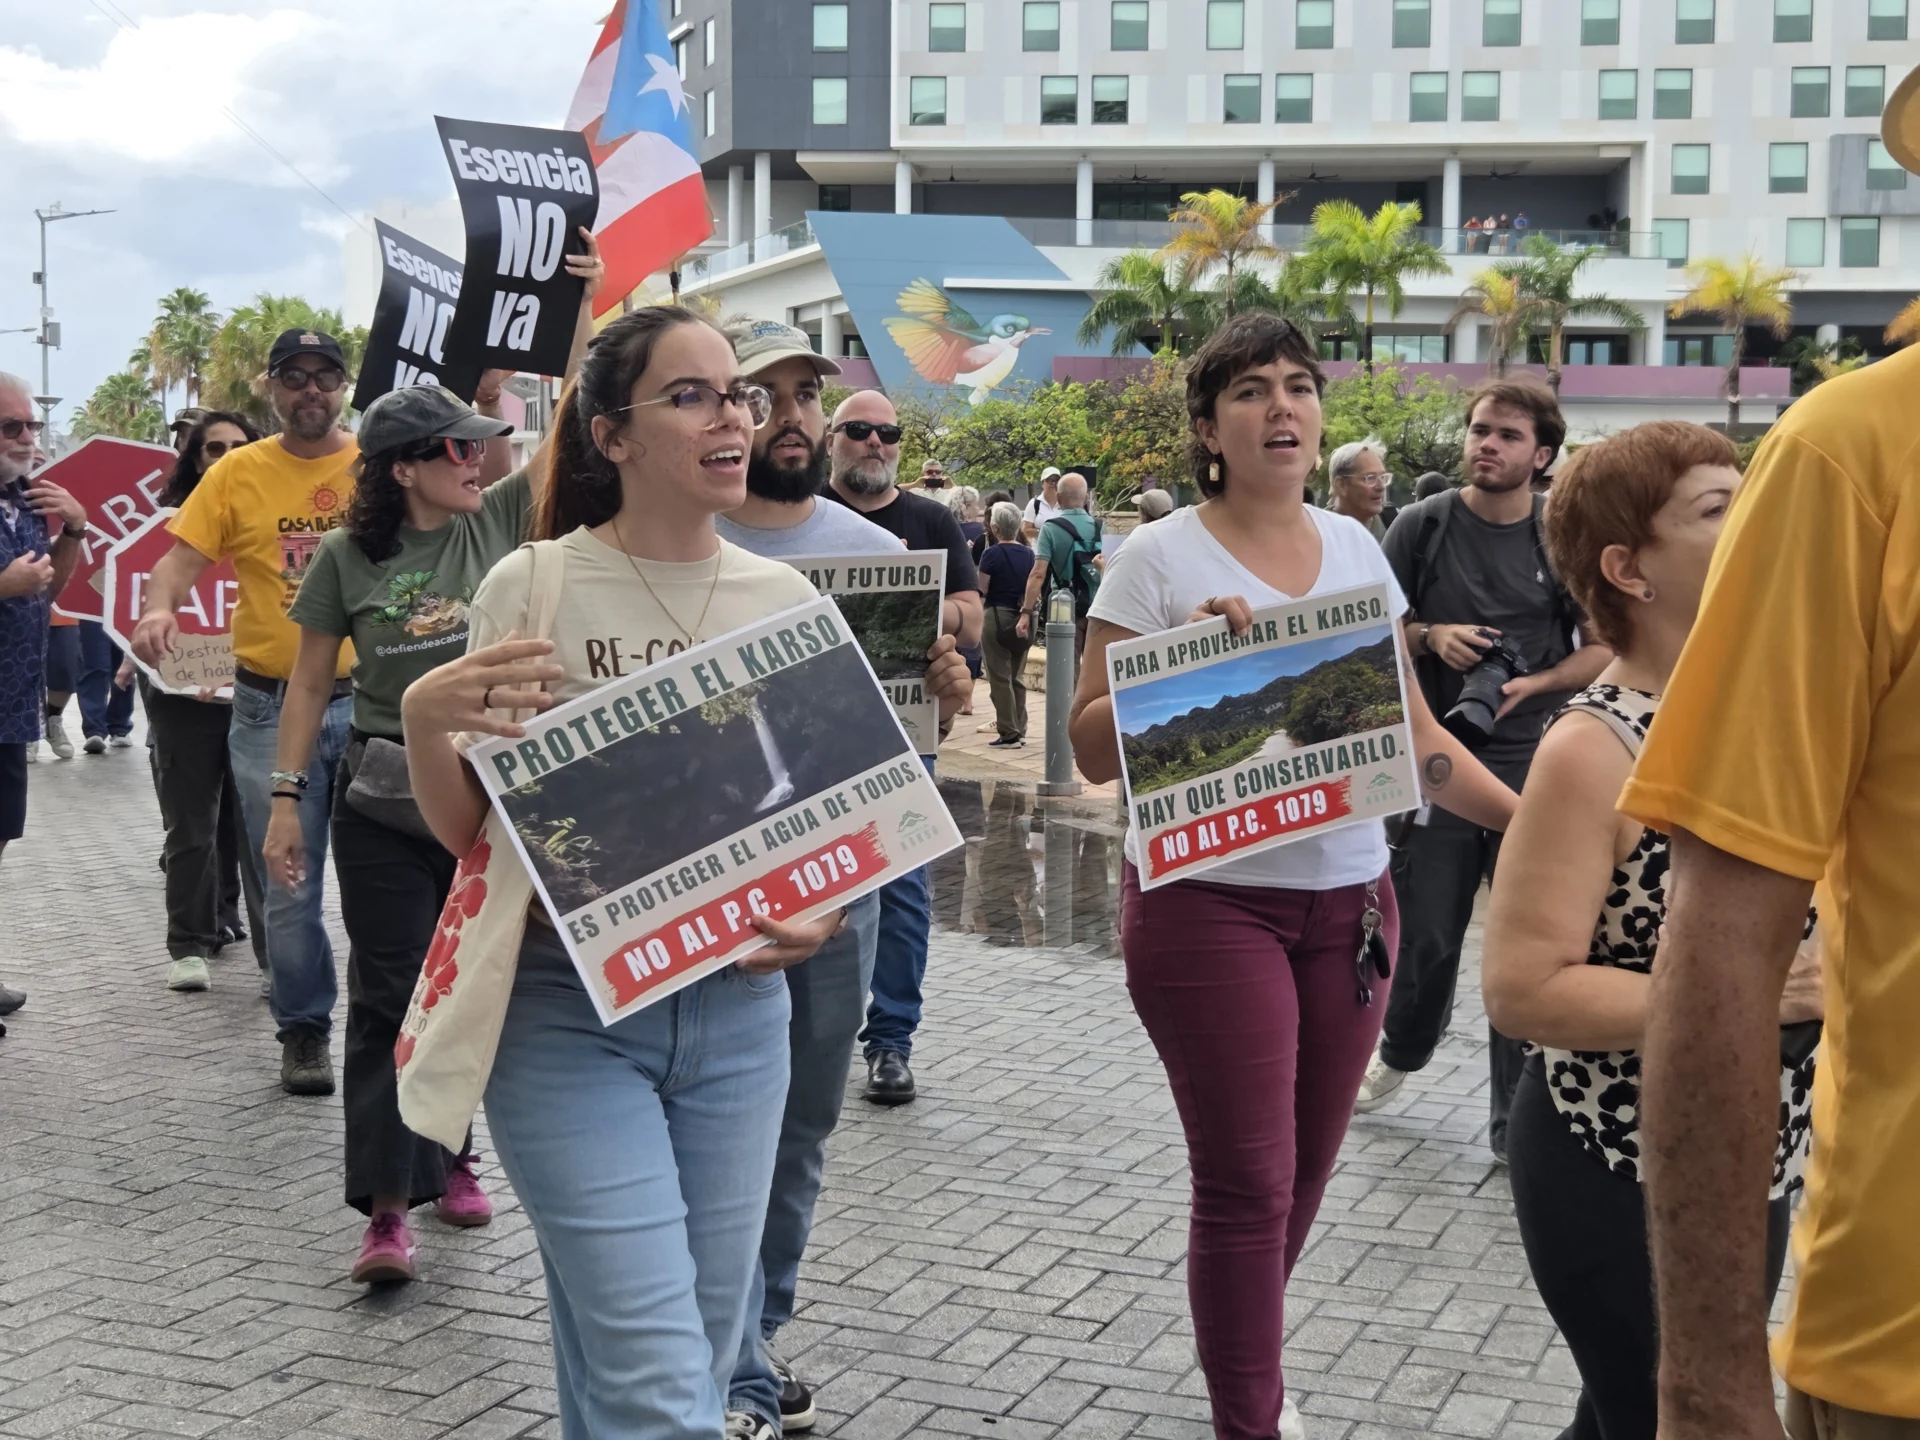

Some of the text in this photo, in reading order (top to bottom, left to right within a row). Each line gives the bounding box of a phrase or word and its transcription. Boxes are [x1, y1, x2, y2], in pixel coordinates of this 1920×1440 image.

[448, 138, 593, 195] Esencia
[496, 195, 567, 282] NO
[398, 286, 456, 366] NO
[486, 290, 540, 352] va
[278, 516, 314, 533] CASA
[801, 565, 939, 589] AY FUTURO.
[175, 665, 196, 681] de
[585, 637, 706, 679] RE-C
[1113, 651, 1160, 682] PARA
[1287, 614, 1308, 637] EL
[1317, 597, 1388, 631] KARSO,
[491, 613, 841, 789] PROTEGER EL KARSO
[1137, 793, 1175, 830] HAY
[1186, 778, 1224, 815] QUE
[1234, 733, 1405, 799] CONSERVARLO.
[566, 761, 923, 945] ES PROTEGER EL AGUA DE TODOS.
[1161, 830, 1189, 862] NO
[1198, 821, 1221, 851] AL
[1226, 808, 1267, 841] P.C.
[1274, 789, 1327, 825] 1079
[623, 844, 859, 982] NO AL P.C. 1079
